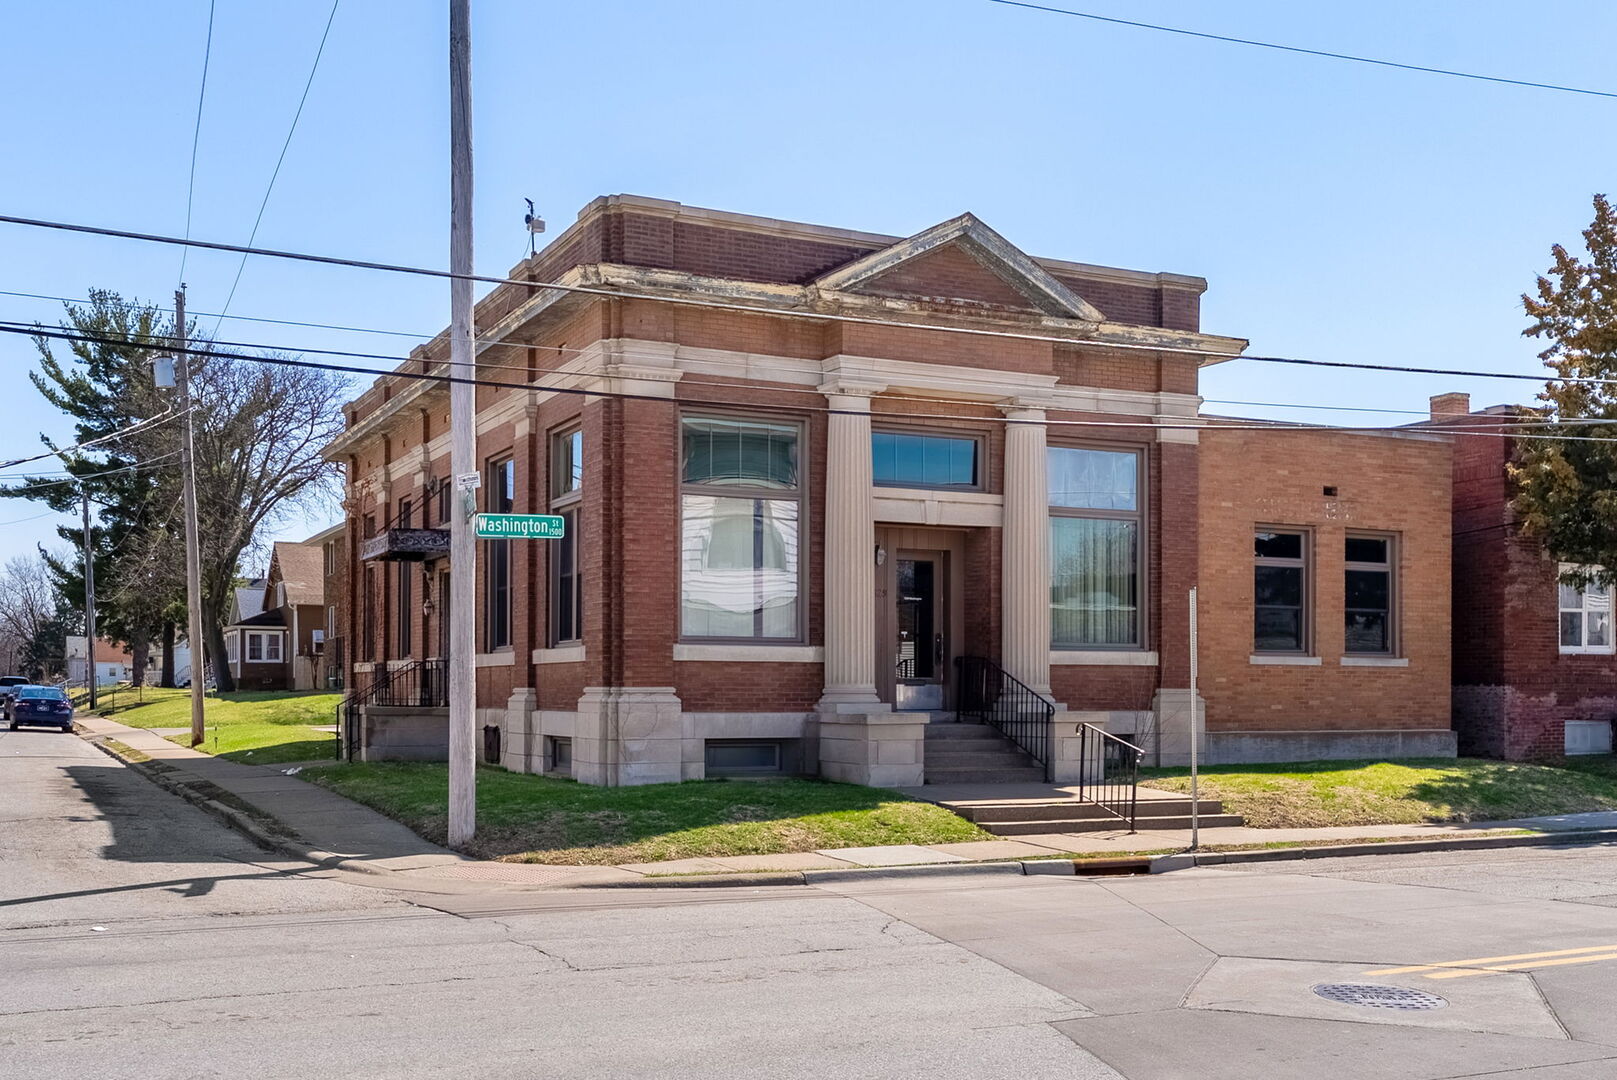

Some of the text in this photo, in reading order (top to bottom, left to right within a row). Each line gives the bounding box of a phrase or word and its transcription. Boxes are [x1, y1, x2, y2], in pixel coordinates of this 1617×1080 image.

[478, 517, 559, 535] Washington St
[548, 528, 562, 536] 1500
